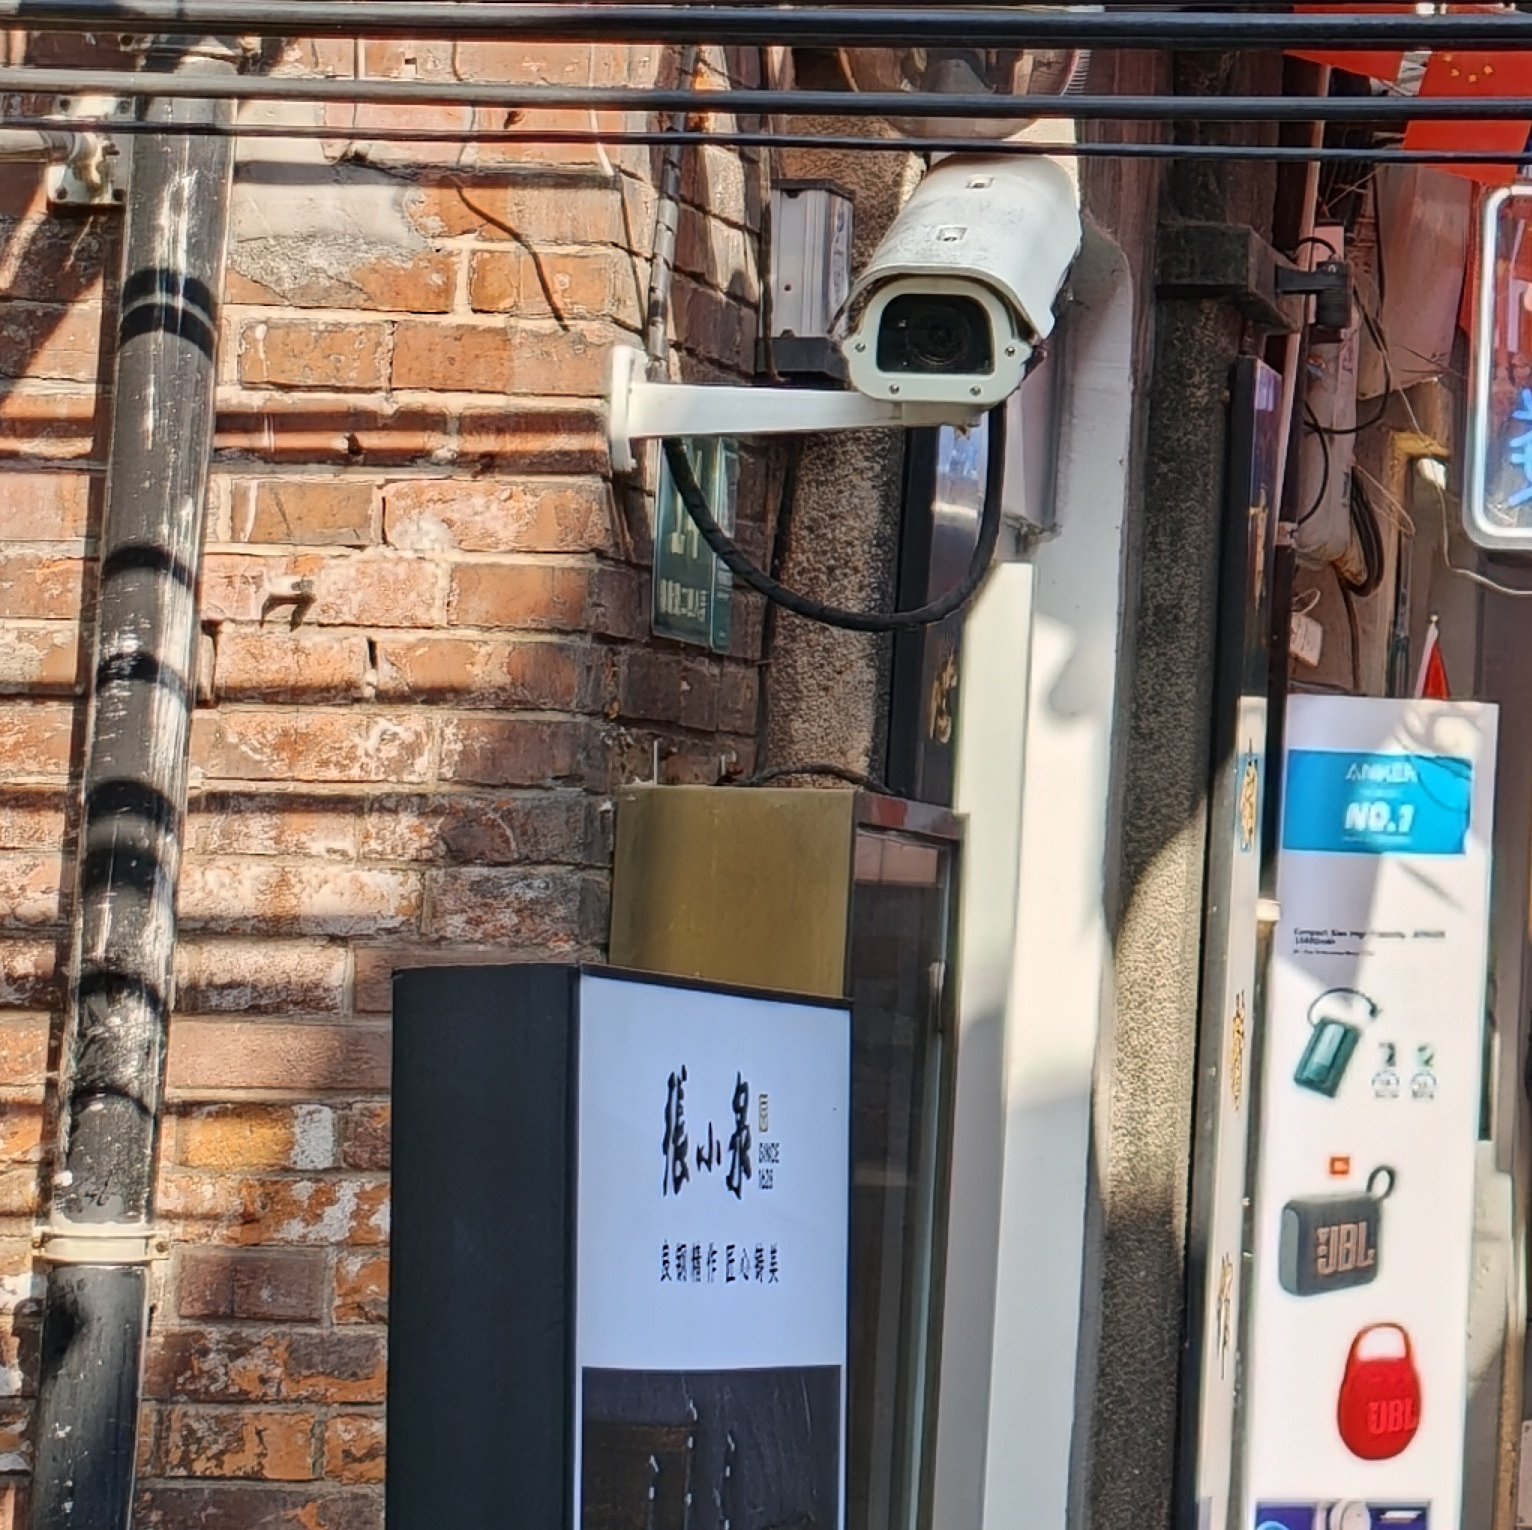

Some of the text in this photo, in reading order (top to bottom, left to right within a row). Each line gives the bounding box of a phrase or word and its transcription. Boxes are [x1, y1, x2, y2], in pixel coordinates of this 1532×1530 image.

[1344, 800, 1415, 832] NO.1
[1315, 1220, 1375, 1278] JBL
[1367, 1396, 1418, 1435] JBL
